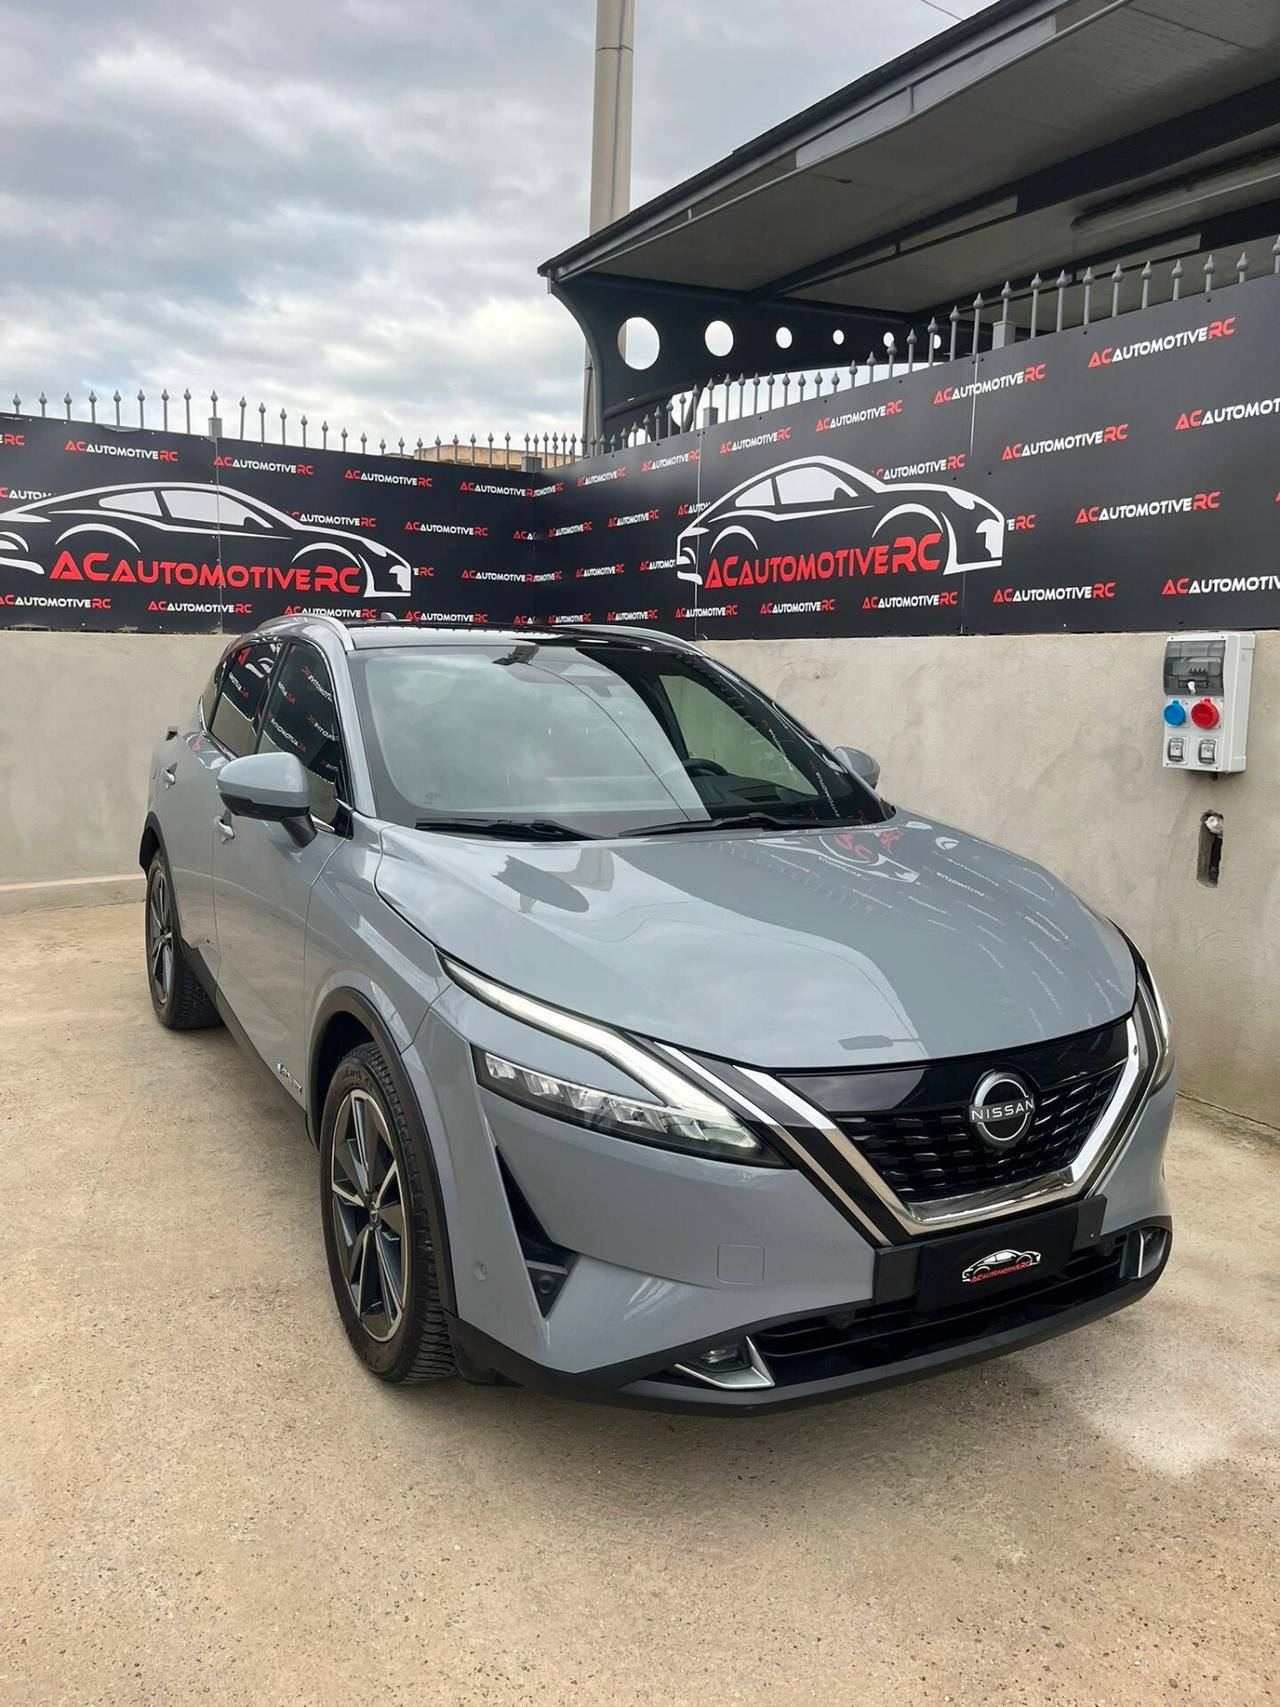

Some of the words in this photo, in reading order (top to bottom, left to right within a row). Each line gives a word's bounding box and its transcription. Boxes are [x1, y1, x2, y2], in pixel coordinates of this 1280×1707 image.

[1088, 317, 1237, 368] ACAUTOMOTIVERC
[933, 364, 1046, 405] ACAUTOMOTIVERC
[815, 400, 904, 432] ACAUTOMOTIVERC
[64, 440, 179, 462] ACAUTOMOTIVERC
[720, 427, 792, 454] ACAUTOMOTIVERC
[1002, 424, 1128, 461] ACAUTOMOTIVERC
[213, 456, 314, 476] ACAUTOMOTIVERC
[344, 469, 433, 488] ACAUTOMOTIVERC
[459, 481, 535, 498] ACAUTOMOTIVER
[1076, 491, 1221, 524] ACAUTOMOTIVERC
[405, 521, 488, 537] ACAUTOMOTIVERC
[50, 549, 362, 594] ACAUTOMOTIVERC
[704, 532, 942, 589] ACAUTOMOTIVERC
[462, 569, 534, 583] ACAUTOMOTIVER
[862, 591, 958, 609] ACAUTOMOTIVERC
[993, 581, 1116, 603] ACAUTOMOTIVERC
[148, 600, 252, 614] ACAUTOMOTIVERC
[405, 611, 489, 624] ACAUTOMOTIVERC
[760, 599, 836, 615] ACAUTOMOTIVERC
[971, 1099, 1034, 1121] NISSAN
